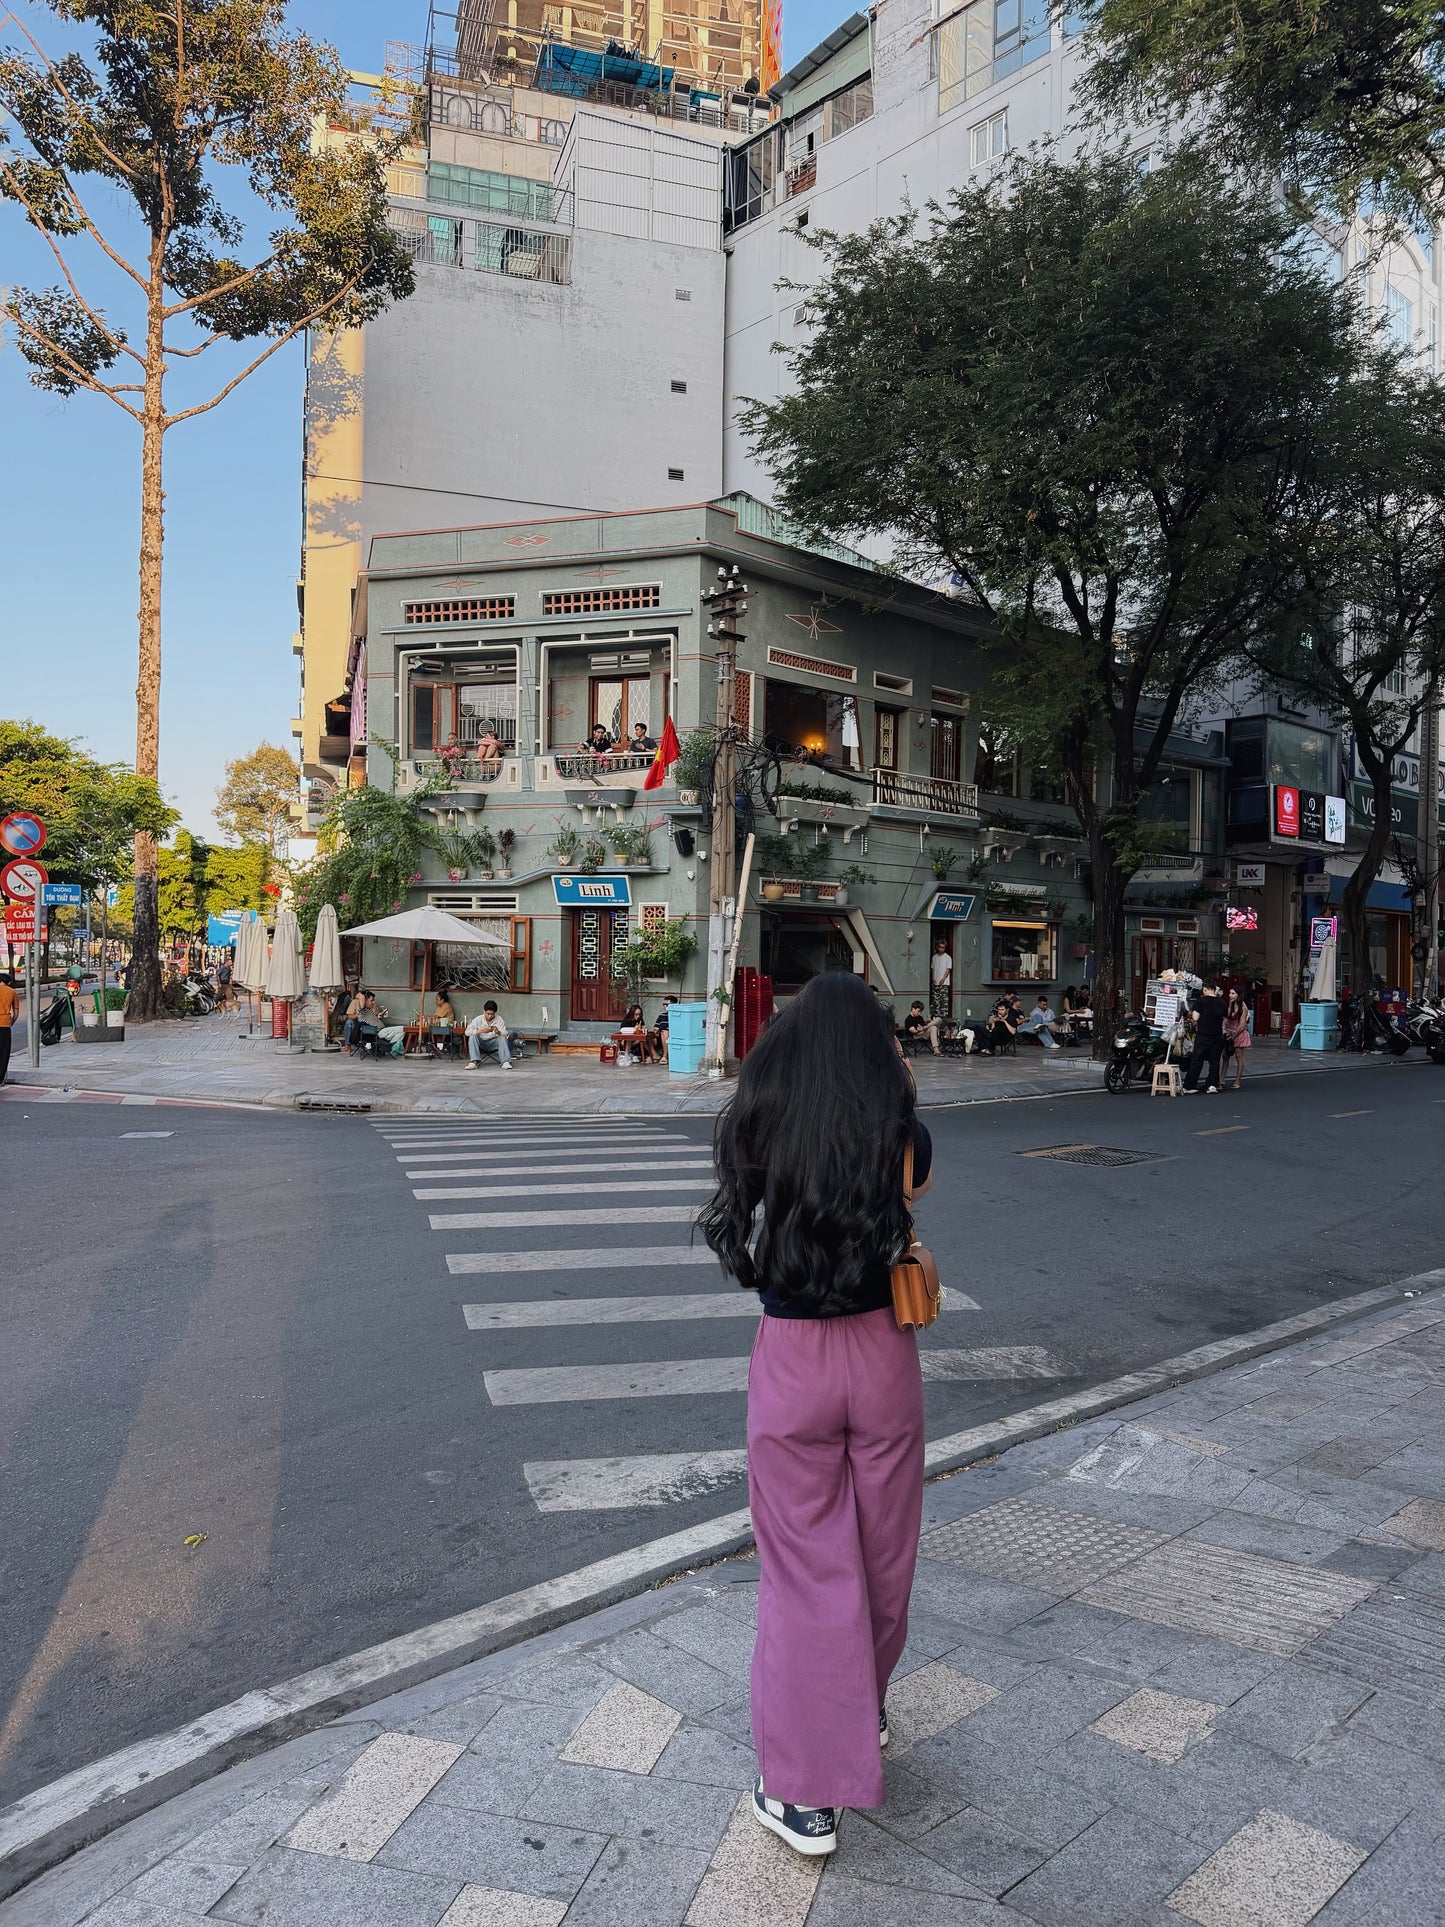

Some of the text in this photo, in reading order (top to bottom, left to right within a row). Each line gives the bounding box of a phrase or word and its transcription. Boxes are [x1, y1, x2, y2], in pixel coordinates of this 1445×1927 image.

[581, 885, 612, 896] Linh
[46, 893, 55, 901] TÔN
[13, 906, 35, 918] CẤM
[6, 920, 15, 929] CÁC
